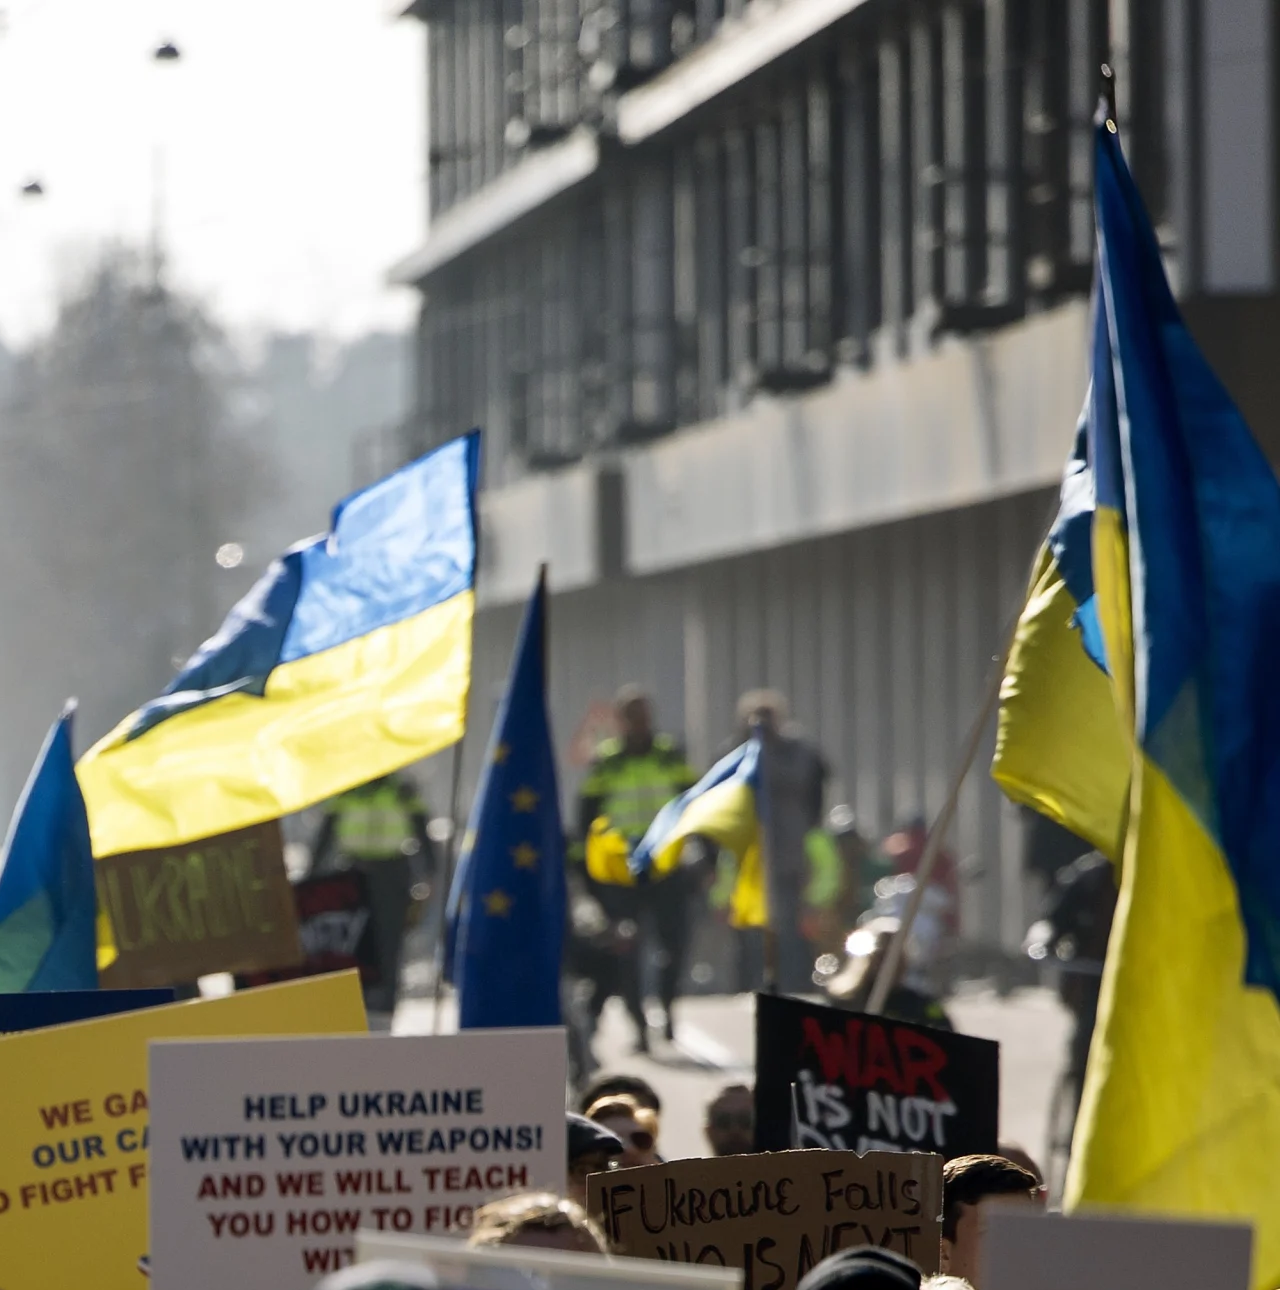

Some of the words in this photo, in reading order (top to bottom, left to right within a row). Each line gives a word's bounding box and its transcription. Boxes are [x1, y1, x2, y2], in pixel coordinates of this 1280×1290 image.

[799, 1015, 951, 1104] WAR
[38, 1098, 95, 1131] WE
[102, 1088, 149, 1119] GA
[243, 1092, 328, 1123] HELP
[339, 1087, 485, 1119] UKRAINE
[866, 1090, 958, 1148] NOT
[31, 1134, 108, 1170] OUR
[179, 1131, 267, 1163] WITH
[276, 1129, 367, 1160] YOUR
[375, 1124, 545, 1155] WEAPONS!
[19, 1168, 119, 1210] FIGHT
[195, 1172, 267, 1202] AND
[275, 1169, 326, 1199] WE
[333, 1167, 414, 1197] WILL
[421, 1162, 529, 1194] TEACH
[206, 1208, 276, 1240] YOU
[285, 1205, 362, 1237] HOW
[369, 1204, 414, 1232] TO
[424, 1202, 482, 1232] FIG
[302, 1246, 356, 1276] WIT
